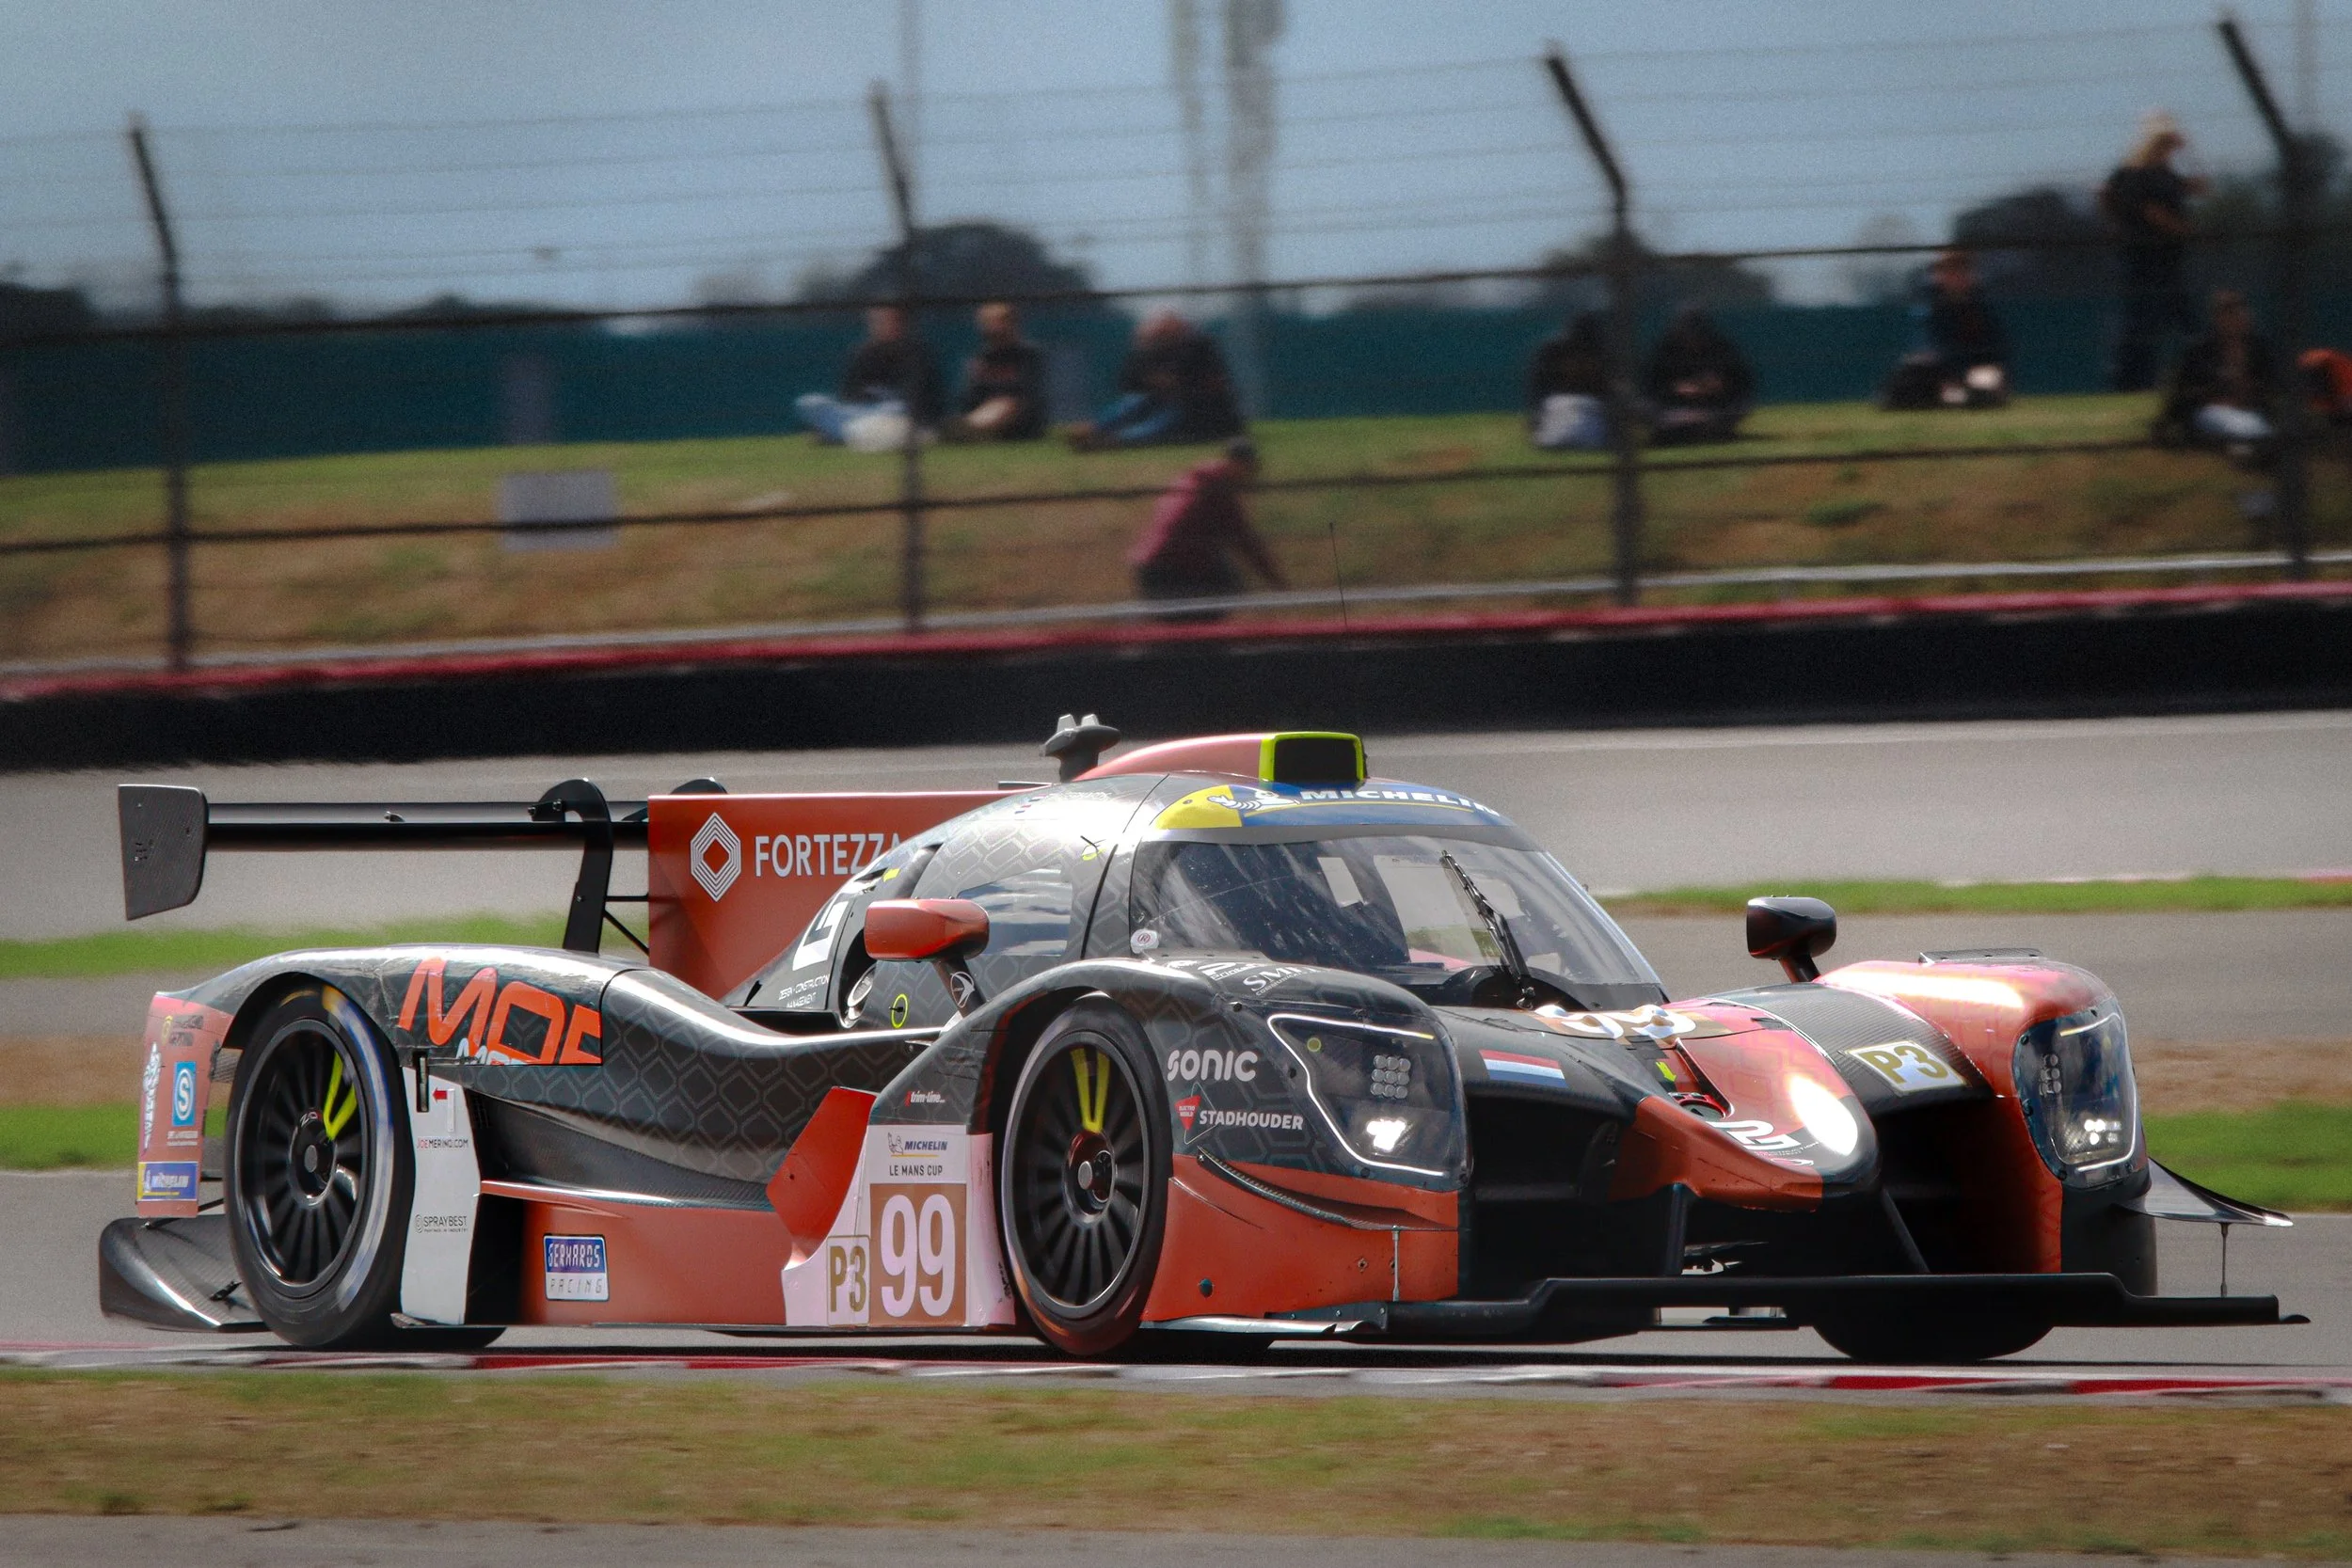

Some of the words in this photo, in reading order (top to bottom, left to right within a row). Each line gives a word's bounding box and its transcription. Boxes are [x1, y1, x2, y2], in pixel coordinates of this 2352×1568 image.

[1300, 790, 1501, 817] MICHELIN
[1859, 1045, 1949, 1084] P3
[1200, 1110, 1304, 1131] STADHOUDER
[904, 1140, 948, 1151] MICHELIN
[889, 1165, 898, 1176] LE
[901, 1165, 925, 1176] MANS
[927, 1165, 943, 1176] CUP
[423, 1215, 468, 1227] SPRAYBEST
[548, 1243, 601, 1268] GERHARDS
[880, 1194, 956, 1317] 99
[829, 1245, 867, 1313] P3
